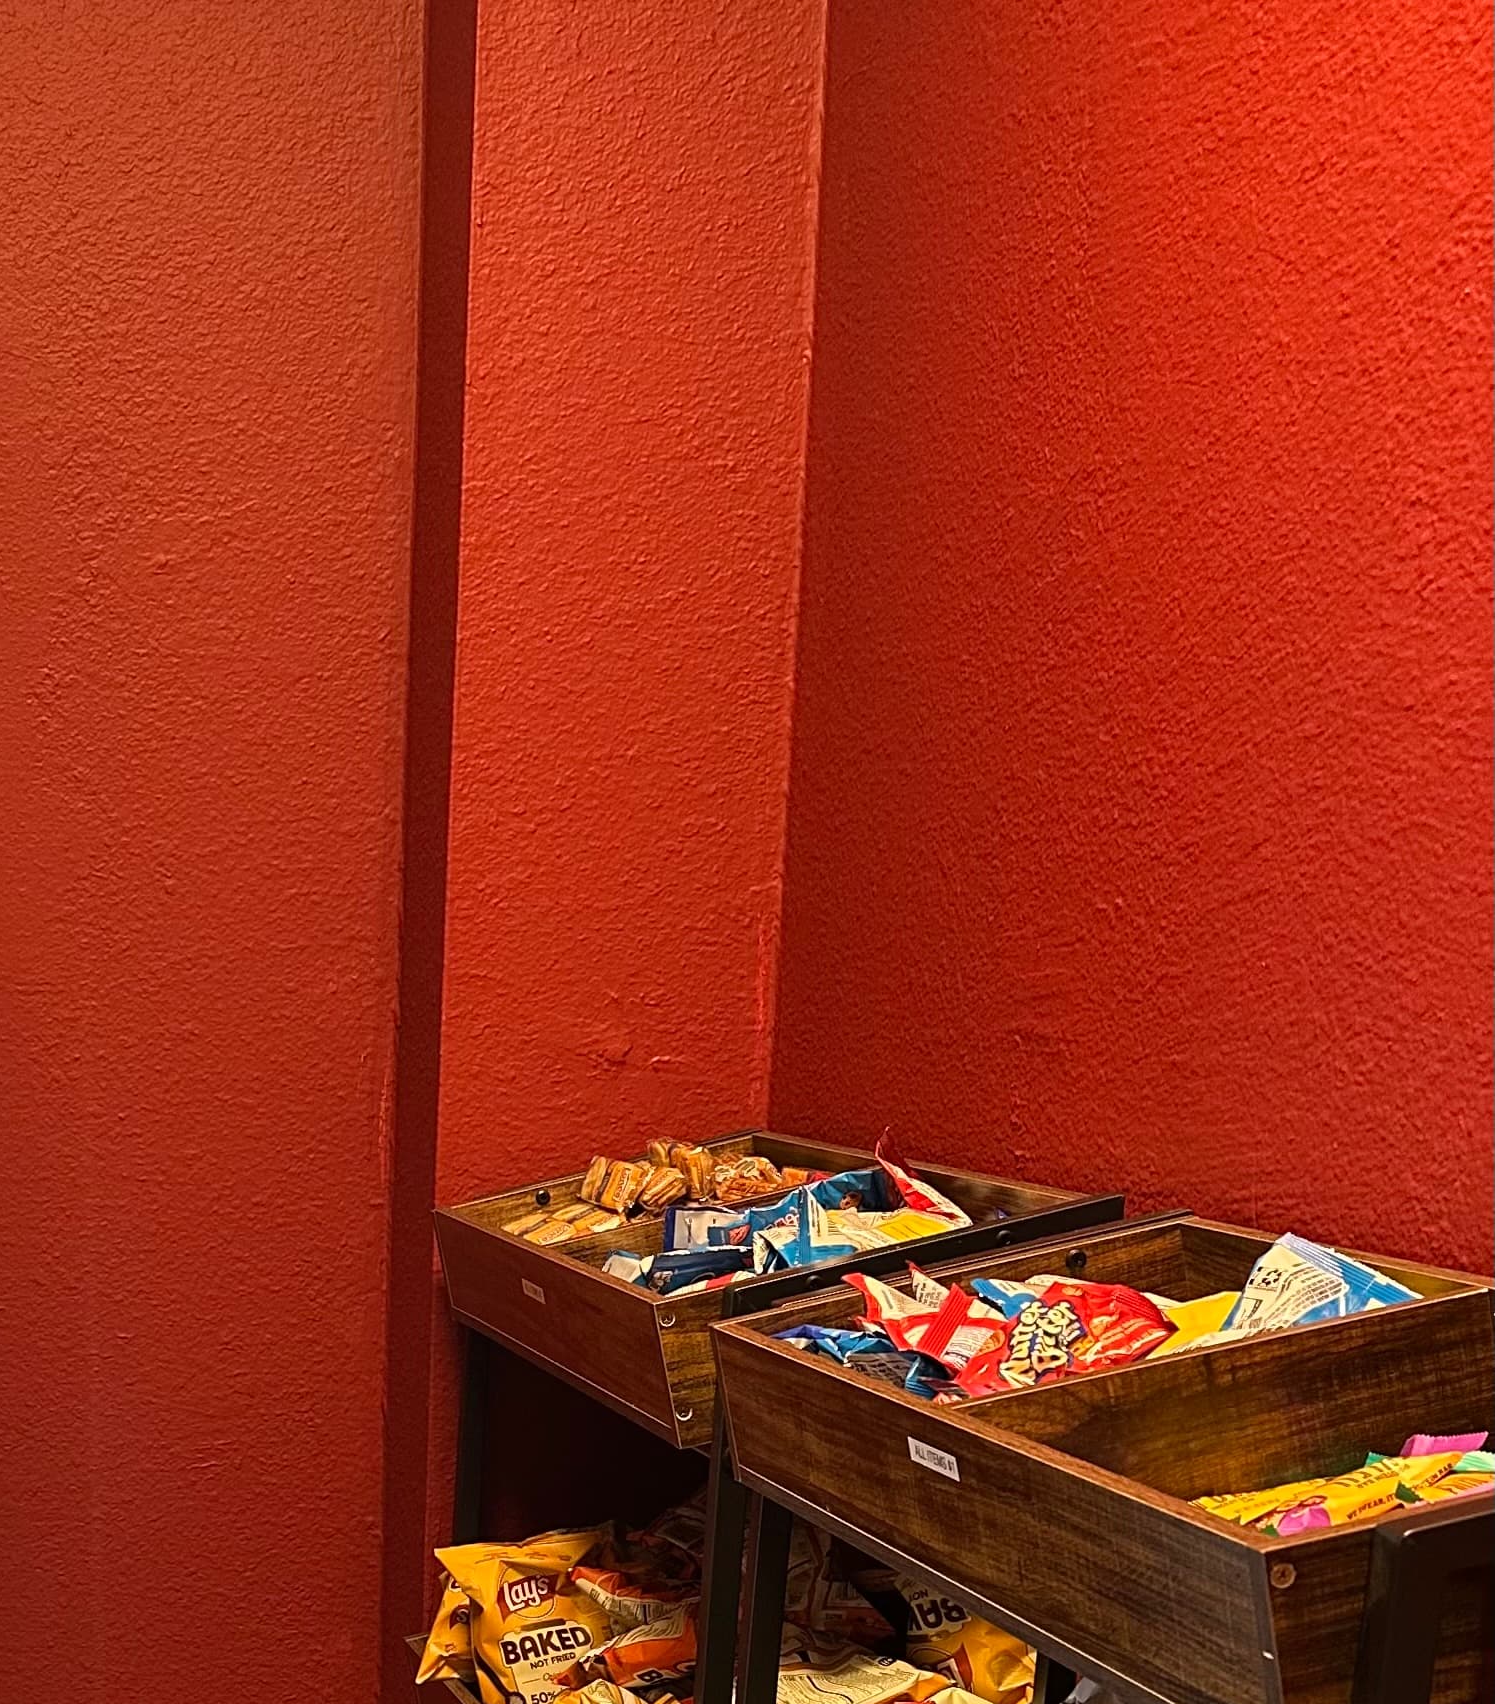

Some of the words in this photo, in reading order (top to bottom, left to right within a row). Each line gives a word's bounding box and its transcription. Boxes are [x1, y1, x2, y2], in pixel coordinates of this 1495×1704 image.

[503, 1574, 551, 1613] Lay's
[498, 1625, 592, 1666] BAKED
[529, 1659, 550, 1670] NOT
[550, 1651, 577, 1665] FRIED
